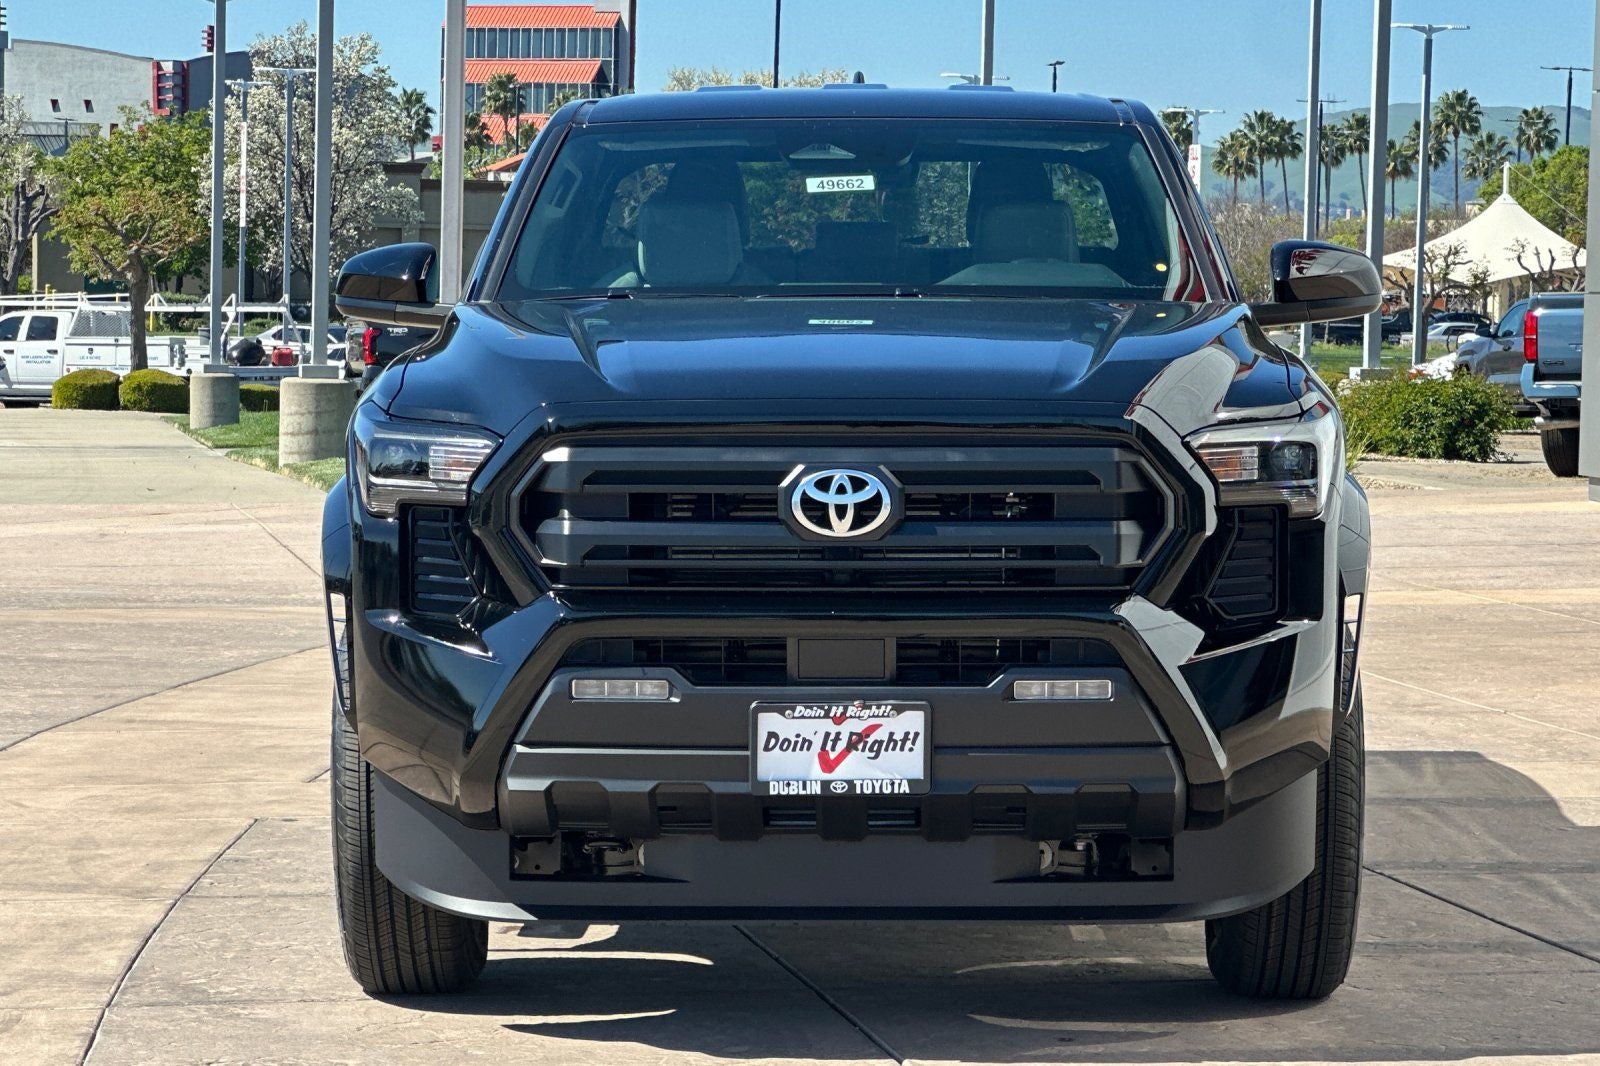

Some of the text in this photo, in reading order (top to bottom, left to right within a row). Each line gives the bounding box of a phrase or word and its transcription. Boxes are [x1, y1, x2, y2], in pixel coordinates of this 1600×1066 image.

[816, 178, 865, 190] 49662
[793, 705, 893, 721] Doin' It Right!
[762, 730, 920, 760] Doin' It Right!
[769, 779, 910, 795] DUBLIN TOYOTA
